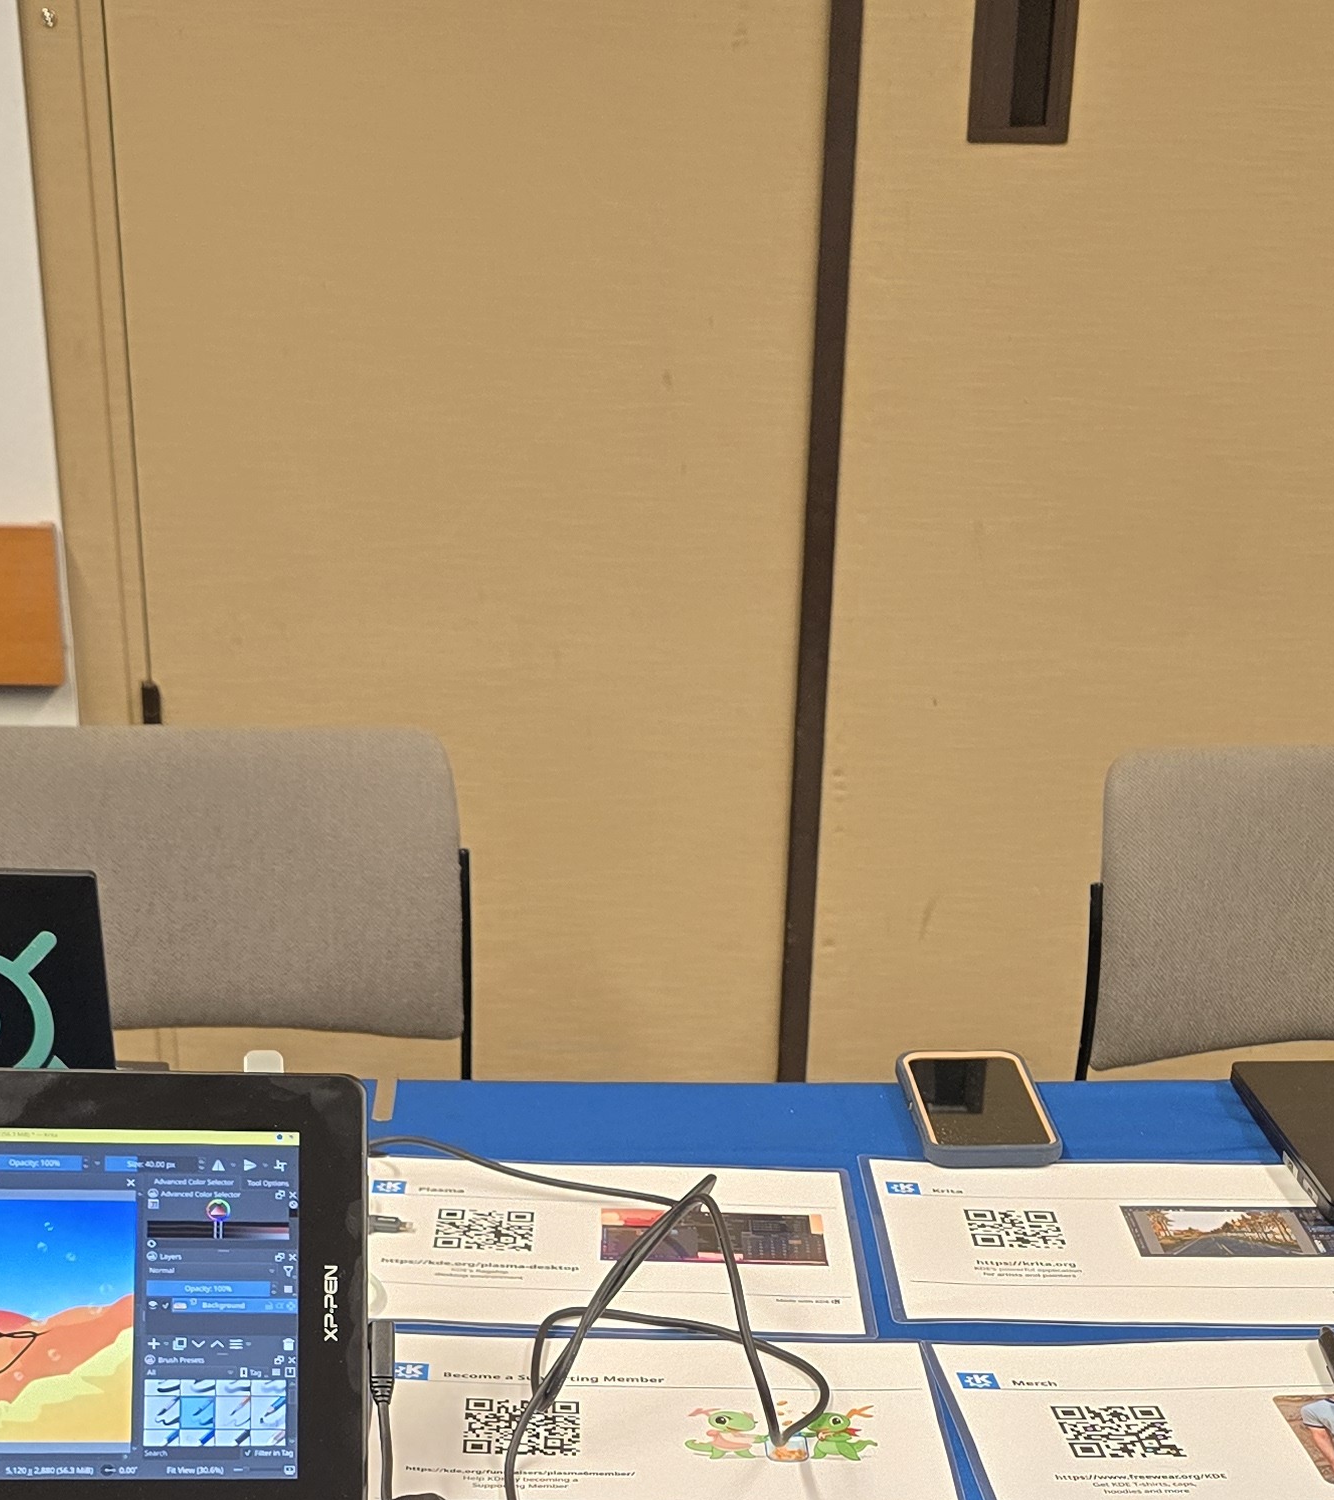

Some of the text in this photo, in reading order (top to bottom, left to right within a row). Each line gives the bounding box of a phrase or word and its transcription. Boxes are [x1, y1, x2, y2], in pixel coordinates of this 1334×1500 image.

[154, 1178, 186, 1186] Advanced
[188, 1178, 206, 1186] Color
[247, 1179, 289, 1188] Tool Options
[160, 1253, 182, 1262] Layers
[976, 1259, 1077, 1268] https://krita.org
[202, 1302, 246, 1310] Background
[443, 1371, 501, 1381] Become
[517, 1374, 599, 1384] Suting
[603, 1375, 665, 1384] Member
[1012, 1379, 1058, 1387] Merch
[1055, 1473, 1227, 1481] https://www.freewear.org/KDE
